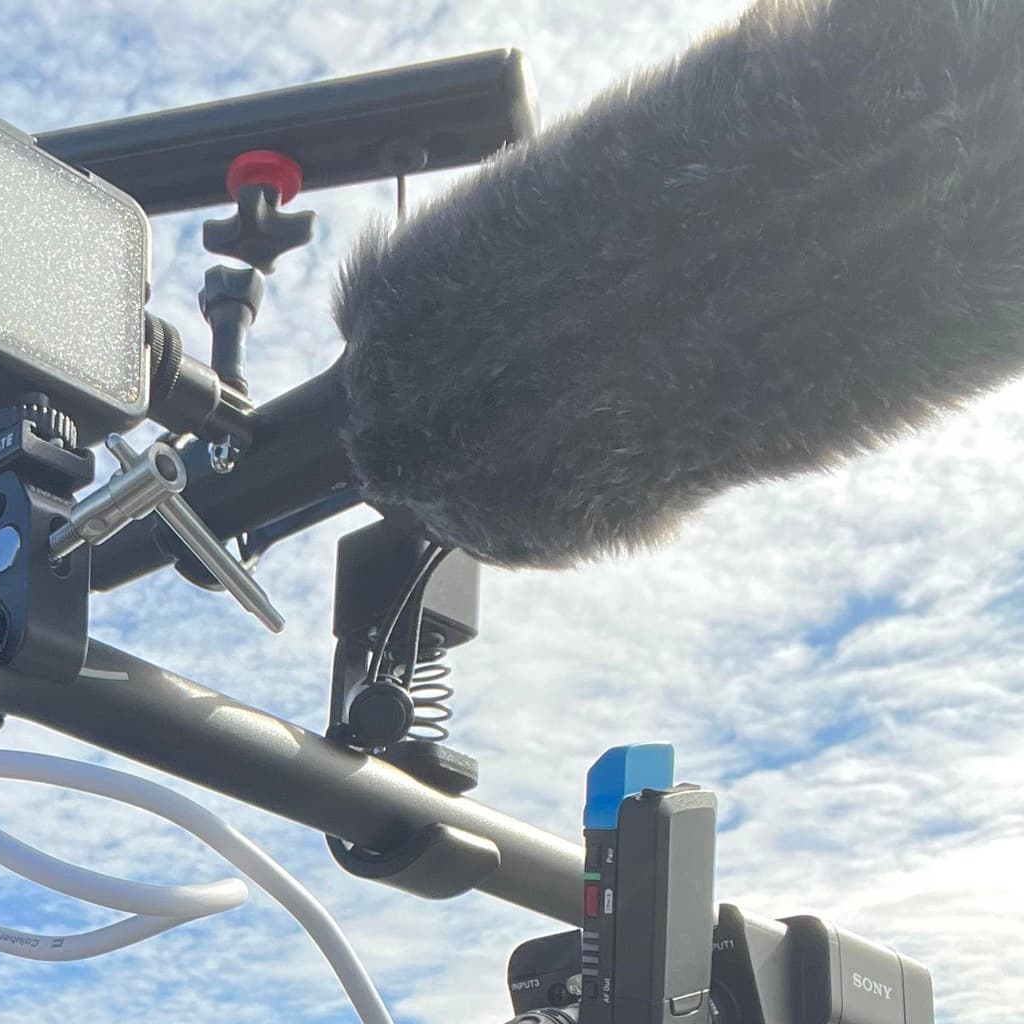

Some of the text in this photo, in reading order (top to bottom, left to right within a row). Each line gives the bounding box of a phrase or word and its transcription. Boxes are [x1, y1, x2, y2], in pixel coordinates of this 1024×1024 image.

[606, 848, 614, 864] Pair
[602, 977, 613, 1004] AF Out
[852, 972, 893, 1000] SONY
